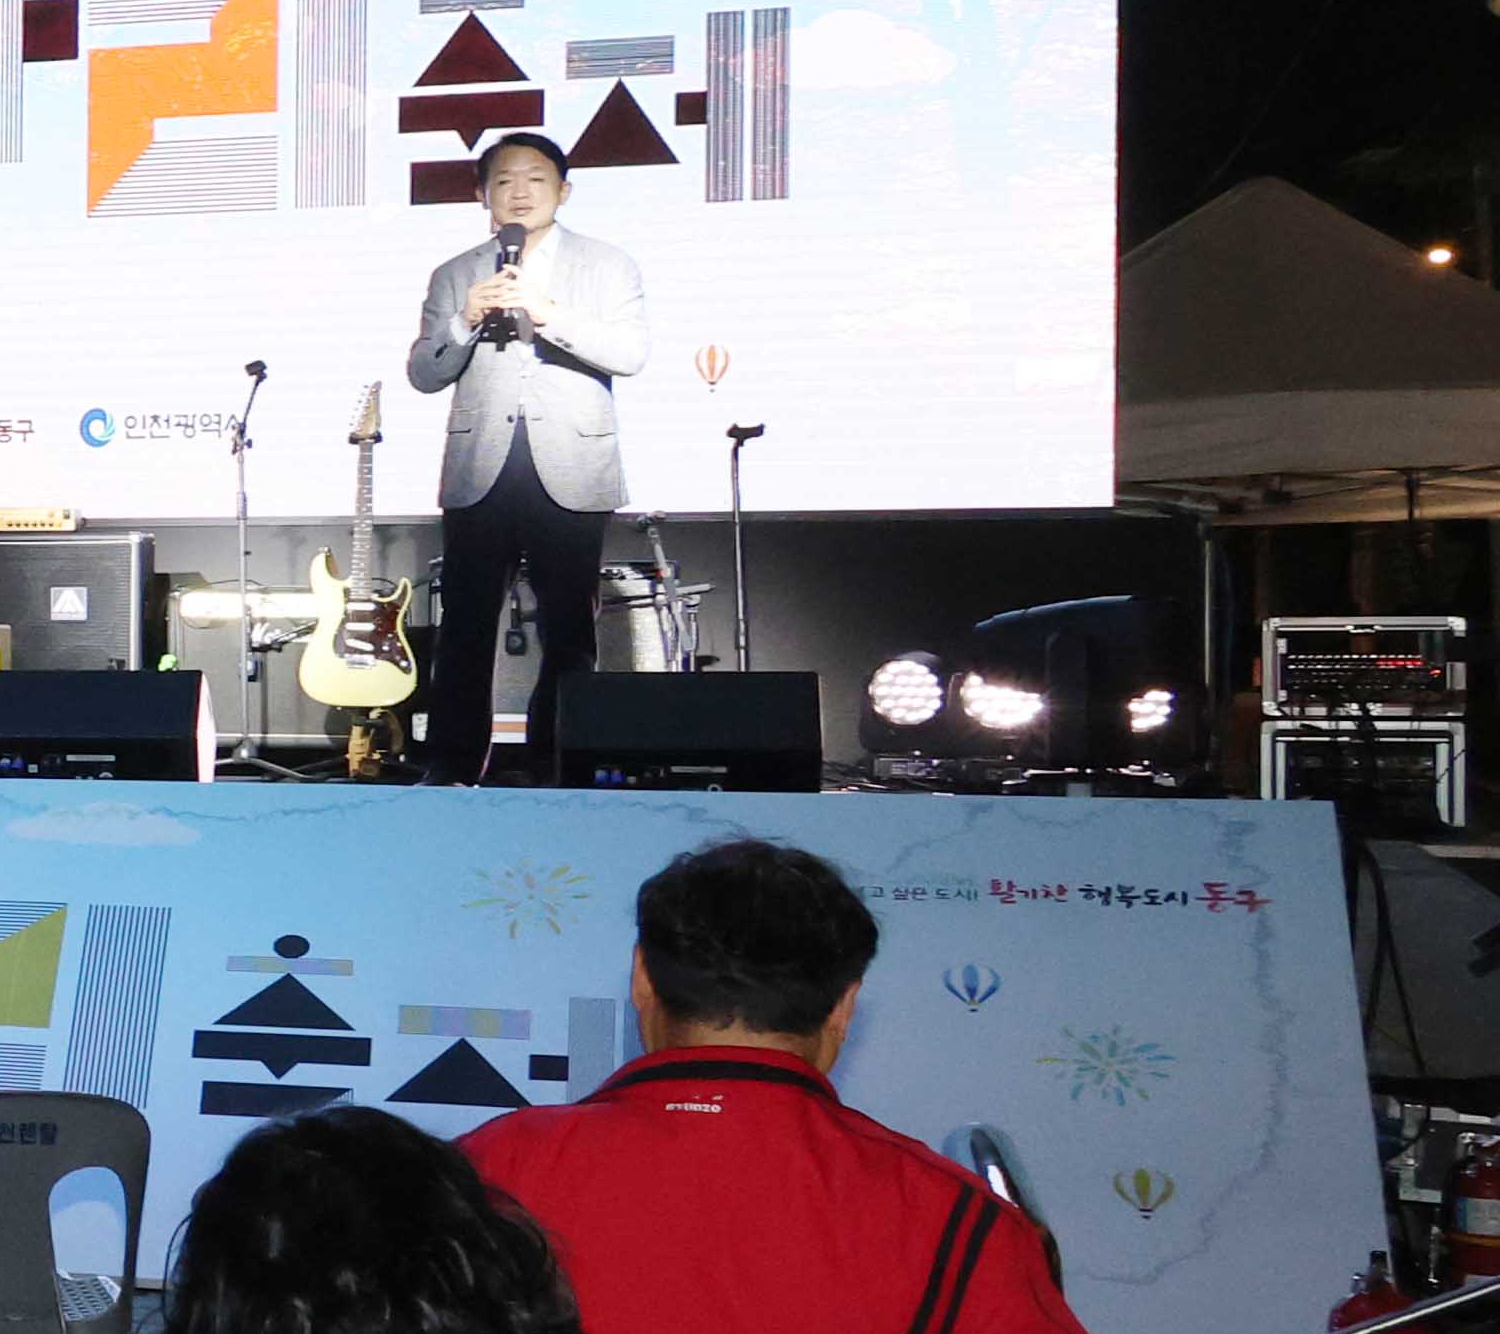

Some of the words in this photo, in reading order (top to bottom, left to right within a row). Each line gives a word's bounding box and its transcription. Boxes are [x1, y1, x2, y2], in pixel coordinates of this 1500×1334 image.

[987, 878, 1068, 904] 활기찬
[1077, 883, 1189, 909] 행복도시
[1195, 880, 1273, 913] 동구
